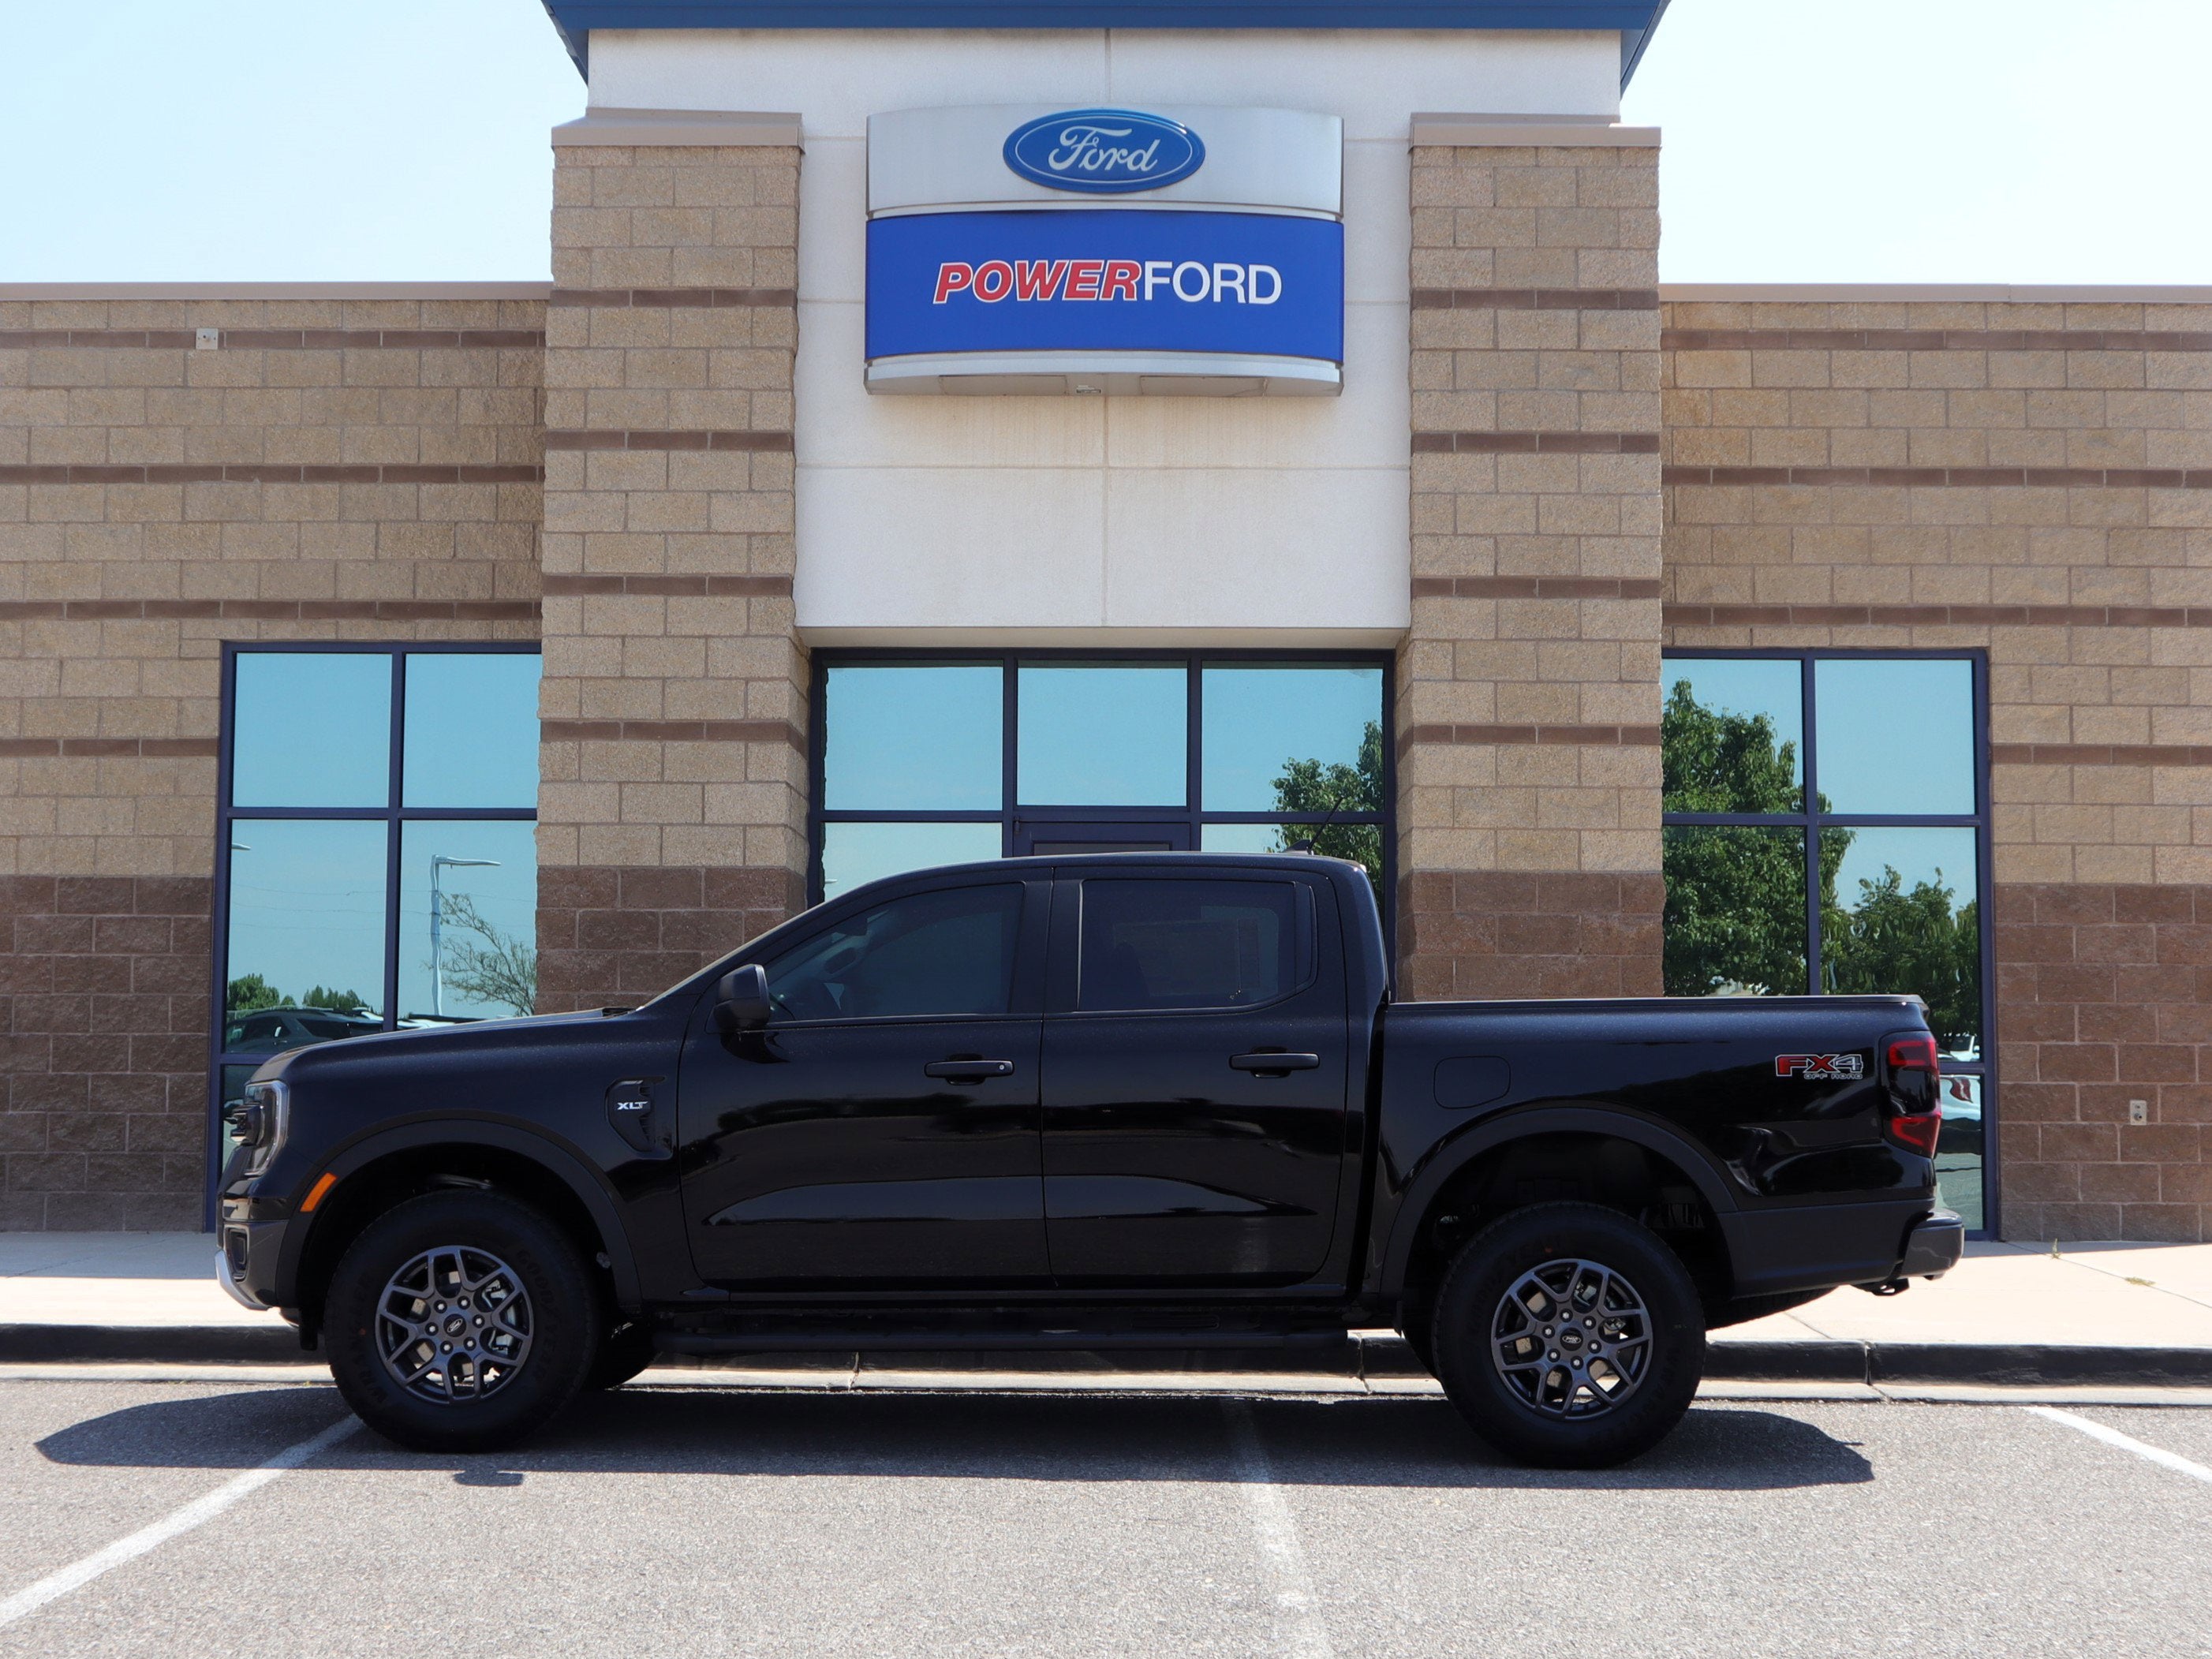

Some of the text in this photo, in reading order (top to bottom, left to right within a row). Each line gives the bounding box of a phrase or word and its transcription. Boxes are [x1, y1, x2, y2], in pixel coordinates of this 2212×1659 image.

[1048, 125, 1160, 172] Ford
[1775, 1054, 1863, 1076] FX4
[617, 1101, 648, 1110] XLT
